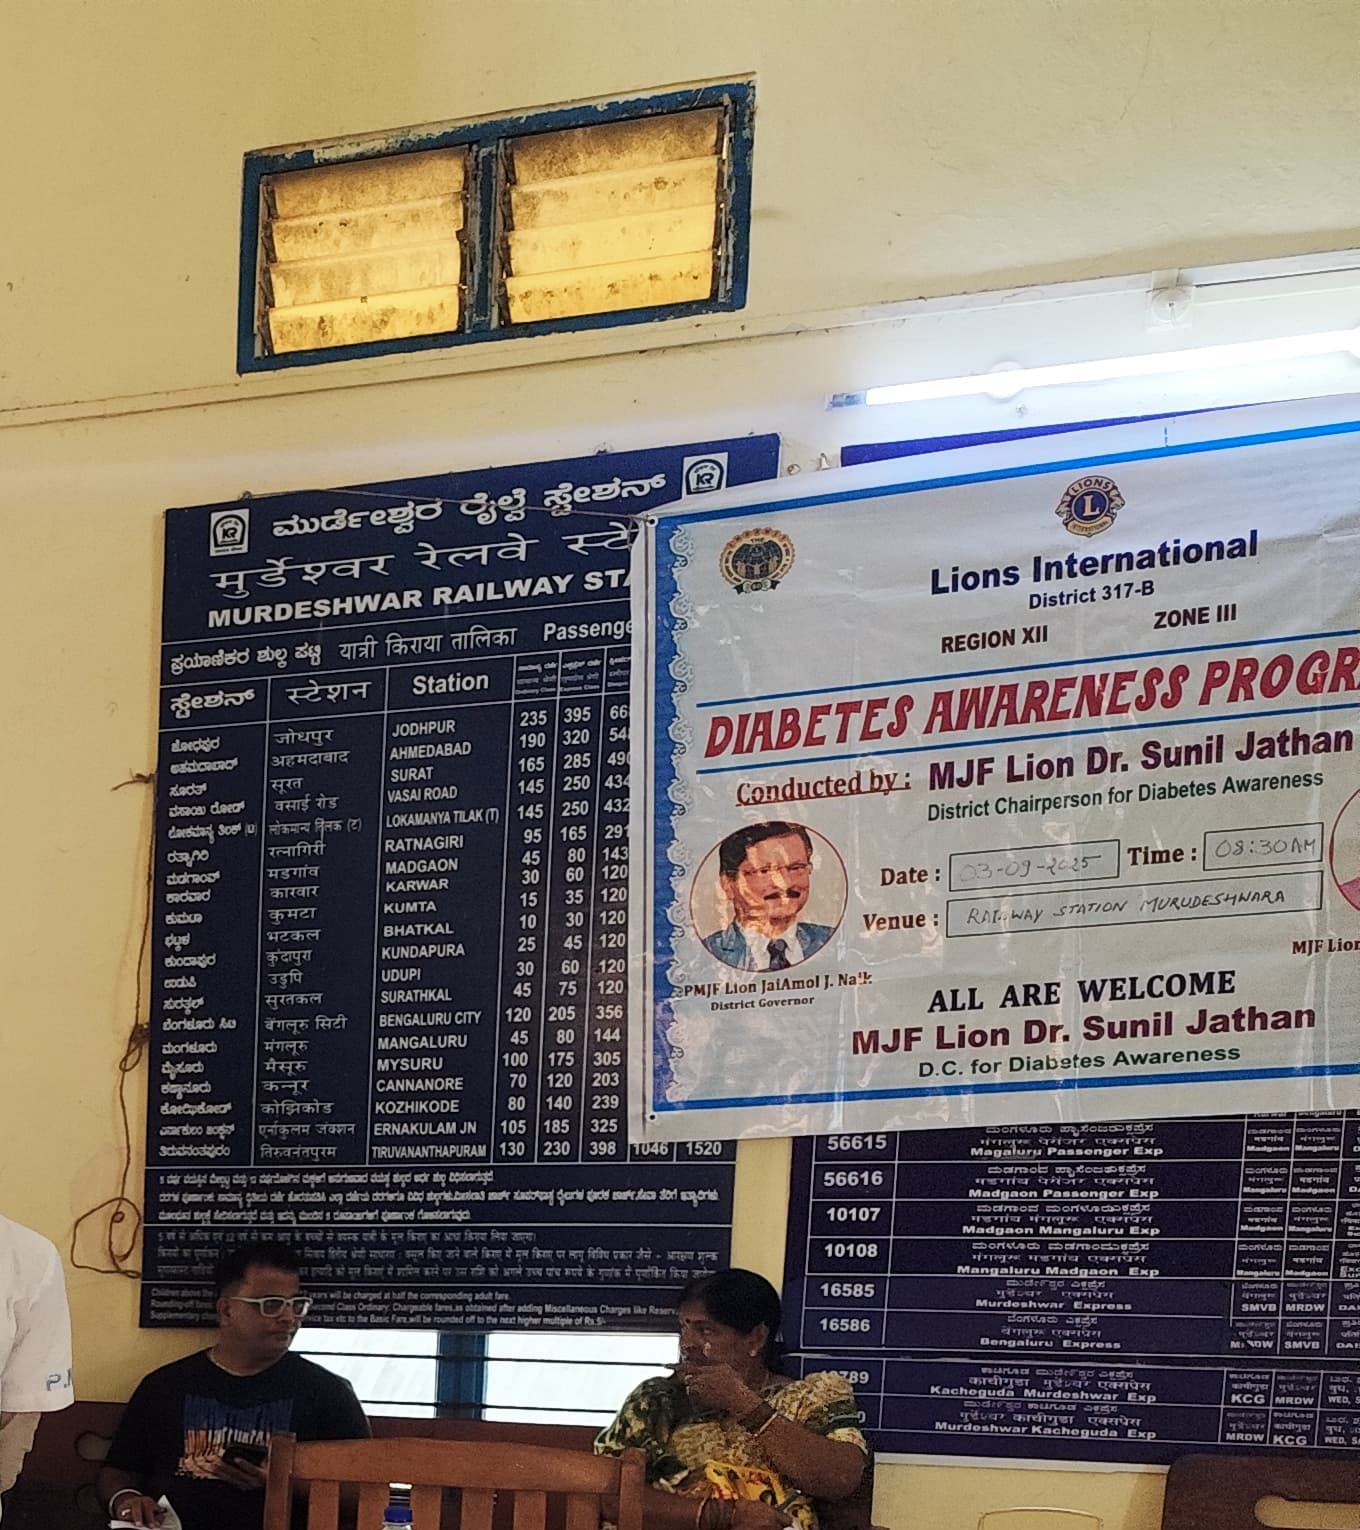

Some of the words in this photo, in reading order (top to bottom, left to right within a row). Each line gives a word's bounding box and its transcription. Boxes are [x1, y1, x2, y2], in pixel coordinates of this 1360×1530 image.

[1071, 478, 1111, 494] LIONS
[1083, 494, 1100, 516] L
[414, 532, 540, 570] रेलवे
[561, 521, 639, 555] स्टे
[930, 559, 1020, 598] Lions
[1032, 530, 1258, 584] International
[208, 589, 422, 628] MURDESHWAR
[433, 574, 574, 605] RAILWAY
[1028, 585, 1095, 610] District
[1101, 580, 1155, 602] 317-B
[1153, 606, 1210, 629] ZONE
[1217, 603, 1237, 624] III
[339, 633, 379, 660] यात्री
[386, 629, 444, 658] किराया
[451, 623, 518, 650] तालिका
[940, 629, 1017, 653] REGION
[1022, 625, 1048, 646] XII
[285, 680, 373, 704] स्टेशन
[412, 673, 489, 696] Station
[705, 695, 912, 758] DIABETES
[922, 664, 1185, 734] AWARENESS
[1199, 644, 1360, 706] PROGR
[519, 710, 547, 727] 235
[563, 706, 592, 723] 395
[392, 719, 456, 738] JODHPUR
[389, 741, 472, 761] AHMEDABAD
[929, 758, 996, 790] MJF
[1006, 752, 1075, 782] Lion
[1086, 744, 1130, 775] Dr.
[1142, 733, 1225, 768] Sunil
[1234, 725, 1353, 762] Jathan
[390, 766, 434, 783] SURAT
[735, 771, 862, 806] Conducted
[869, 766, 898, 796] by
[927, 797, 990, 822] District
[994, 788, 1102, 819] Chairperson
[1105, 785, 1132, 808] for
[1137, 778, 1218, 804] Diabetes
[1221, 769, 1324, 799] Awareness
[384, 835, 464, 853] RATNAGIRI
[385, 858, 459, 874] MADGAON
[1127, 846, 1186, 866] Time
[880, 865, 929, 888] Date
[1052, 901, 1128, 917] STATION
[1139, 890, 1285, 911] MURUDESHWARA
[383, 923, 454, 937] BHATKAL
[863, 912, 926, 932] Venue
[1292, 939, 1324, 956] MJF
[381, 968, 421, 982] UDUPI
[684, 982, 721, 998] PMJF
[725, 981, 757, 995] Lion
[927, 988, 983, 1014] ALL
[1000, 981, 1059, 1008] ARE
[1077, 968, 1236, 1003] WELCOME
[710, 1000, 755, 1012] District
[758, 996, 815, 1009] Governor
[851, 1028, 923, 1056] MJF
[936, 1021, 1010, 1049] Lion
[1023, 1016, 1070, 1046] Dr.
[1082, 1010, 1174, 1041] Sunil
[1186, 1003, 1316, 1035] Jathan
[377, 1035, 468, 1050] MANGALURU
[918, 1057, 964, 1079] D.C.
[970, 1054, 1002, 1075] for
[1008, 1049, 1105, 1073] Diabetes
[1113, 1043, 1241, 1067] Awareness
[375, 1100, 460, 1114] KOZHIKODE
[499, 1141, 525, 1156] 130
[543, 1141, 571, 1156] 230
[589, 1141, 617, 1156] 398
[823, 1170, 883, 1186] 56616
[968, 1188, 1038, 1200] Madgaon
[826, 1207, 881, 1221] 10107
[819, 1281, 876, 1299] 16585
[1230, 1393, 1265, 1404] KCG
